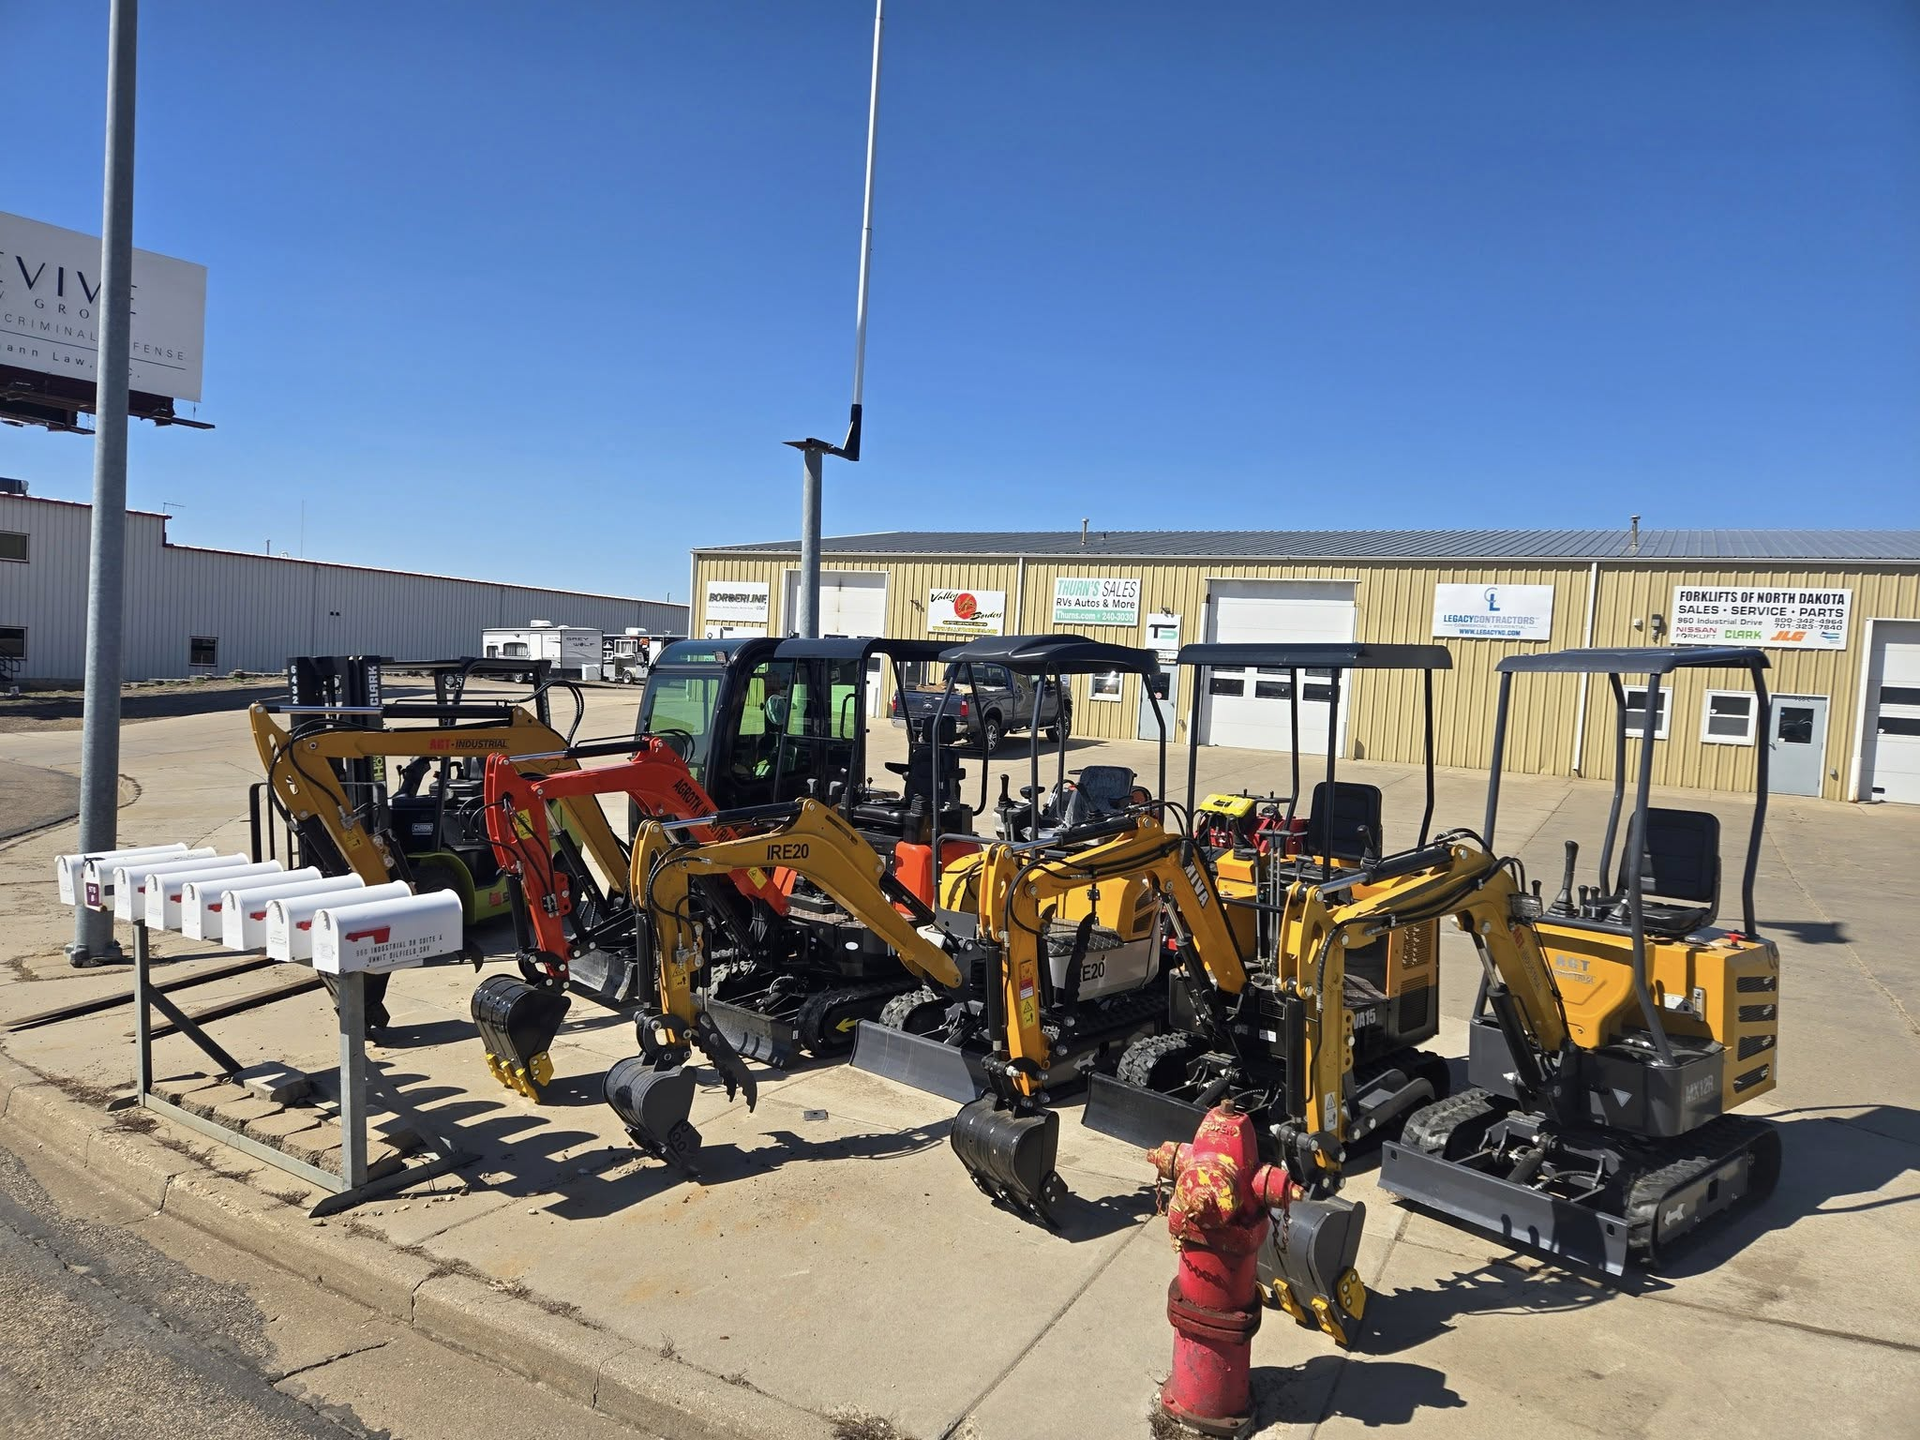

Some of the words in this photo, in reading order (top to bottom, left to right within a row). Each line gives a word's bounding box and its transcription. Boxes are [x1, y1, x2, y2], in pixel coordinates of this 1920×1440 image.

[0, 251, 138, 315] VIV
[4, 313, 97, 341] CRIMINAL
[132, 342, 185, 361] FENSE
[0, 343, 39, 357] ann
[1057, 580, 1100, 597] THURN'S
[1102, 580, 1137, 598] SALES
[931, 591, 958, 603] Valley
[1056, 597, 1072, 607] RVs
[1074, 598, 1100, 608] Autos
[1102, 599, 1110, 608] &
[1112, 599, 1136, 609] More
[1680, 591, 1738, 603] FORKLIFTS
[1741, 591, 1755, 603] OF
[1757, 592, 1796, 604] NORTH
[1799, 593, 1845, 605] DAKOTA
[1057, 611, 1096, 621] Thurns.com
[1102, 612, 1134, 622] 240-3030
[1679, 605, 1719, 614] SALES
[1731, 606, 1787, 616] SERVICE
[1799, 607, 1844, 618] PARTS
[1697, 617, 1737, 625] Industrial
[1740, 618, 1763, 626] Drive
[1774, 623, 1843, 631] 701-323-7840
[1725, 630, 1762, 640] CLARK
[1770, 631, 1807, 641] JLG
[367, 665, 380, 706] CLARK
[455, 739, 508, 748] INDUSTRIAL
[672, 778, 703, 807] AGROTK
[766, 843, 810, 861] IRE20
[371, 941, 407, 954] INDUSTRIAL
[419, 935, 436, 945] SUITE
[389, 947, 417, 959] OILFIELD
[1081, 961, 1105, 982] E20
